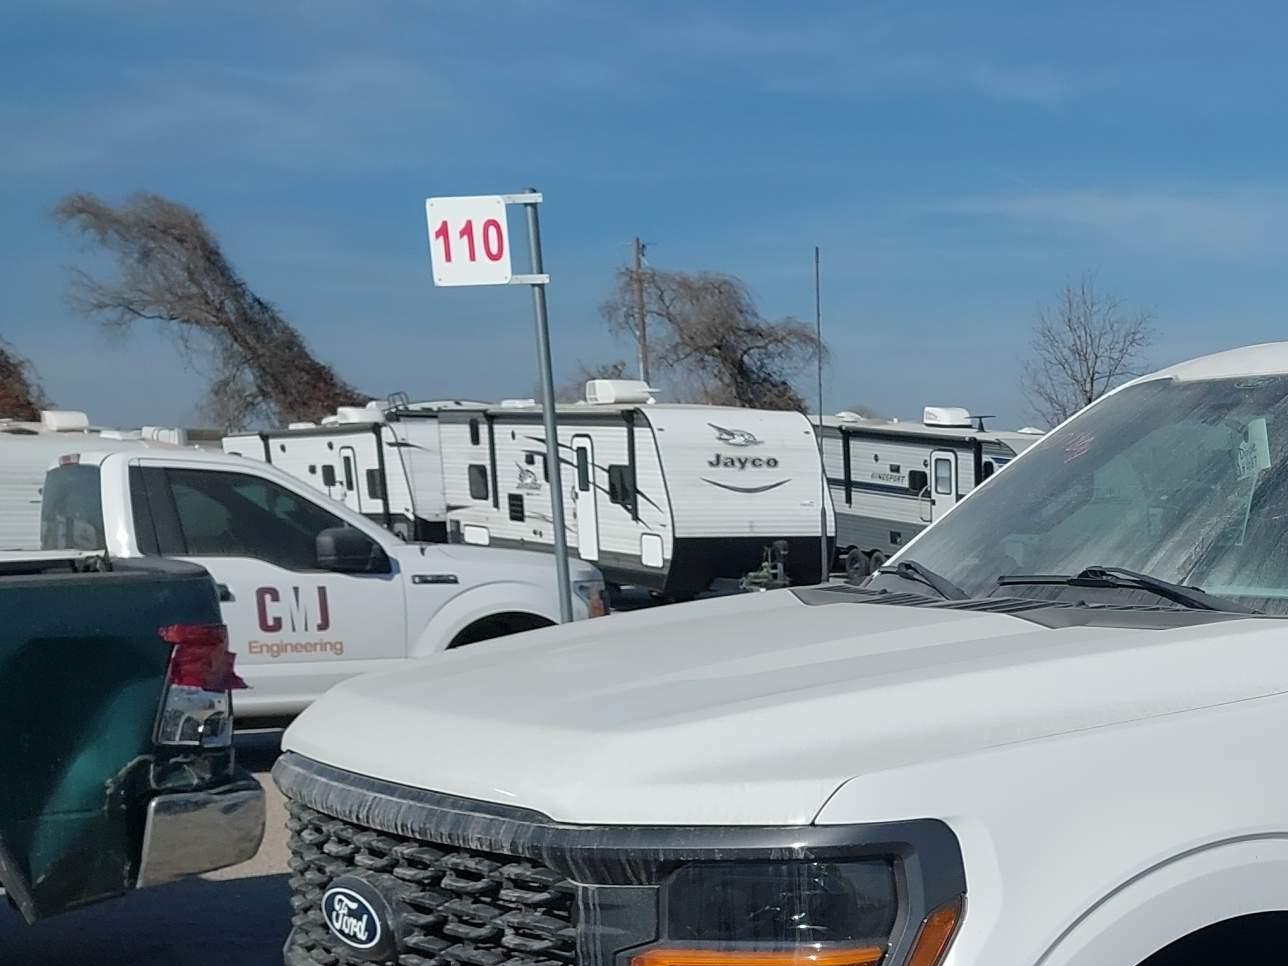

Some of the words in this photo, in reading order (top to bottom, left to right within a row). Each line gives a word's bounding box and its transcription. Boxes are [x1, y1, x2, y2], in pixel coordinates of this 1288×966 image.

[435, 219, 504, 262] 110
[707, 453, 779, 470] Jayco
[256, 586, 329, 632] CMJ
[248, 639, 344, 658] Engineering
[332, 894, 369, 940] Ford
